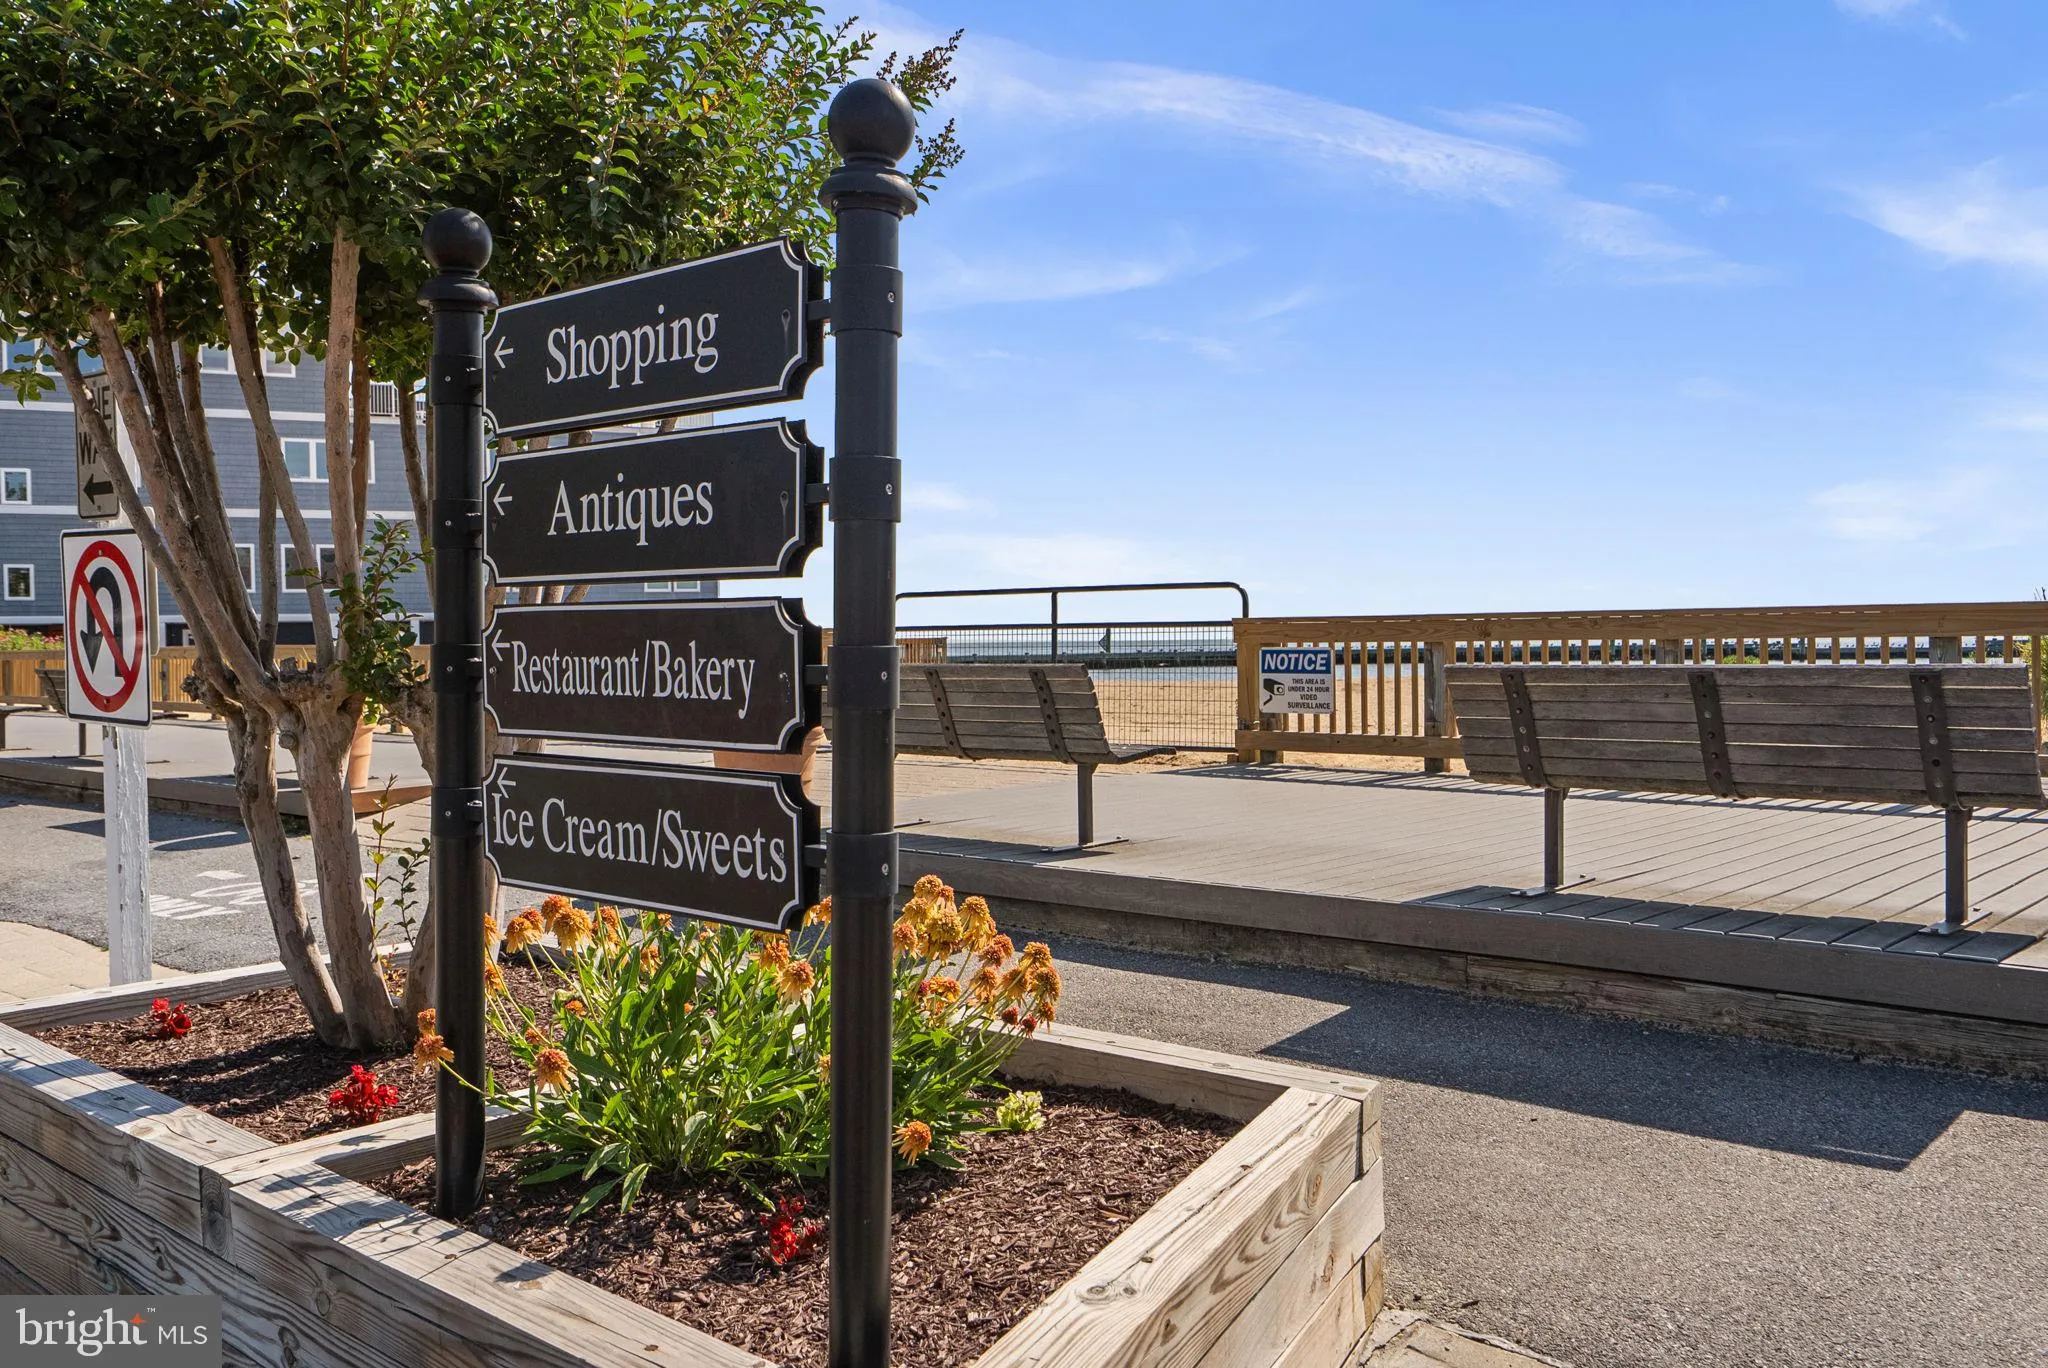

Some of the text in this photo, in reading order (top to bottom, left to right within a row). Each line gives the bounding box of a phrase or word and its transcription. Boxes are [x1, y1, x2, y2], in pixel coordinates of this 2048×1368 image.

[546, 304, 719, 389] Shopping
[547, 473, 713, 546] Antiques
[511, 639, 755, 720] Restaurant/Bakery
[1264, 653, 1328, 671] NOTICE
[491, 792, 787, 883] Ice Cream/Sweets
